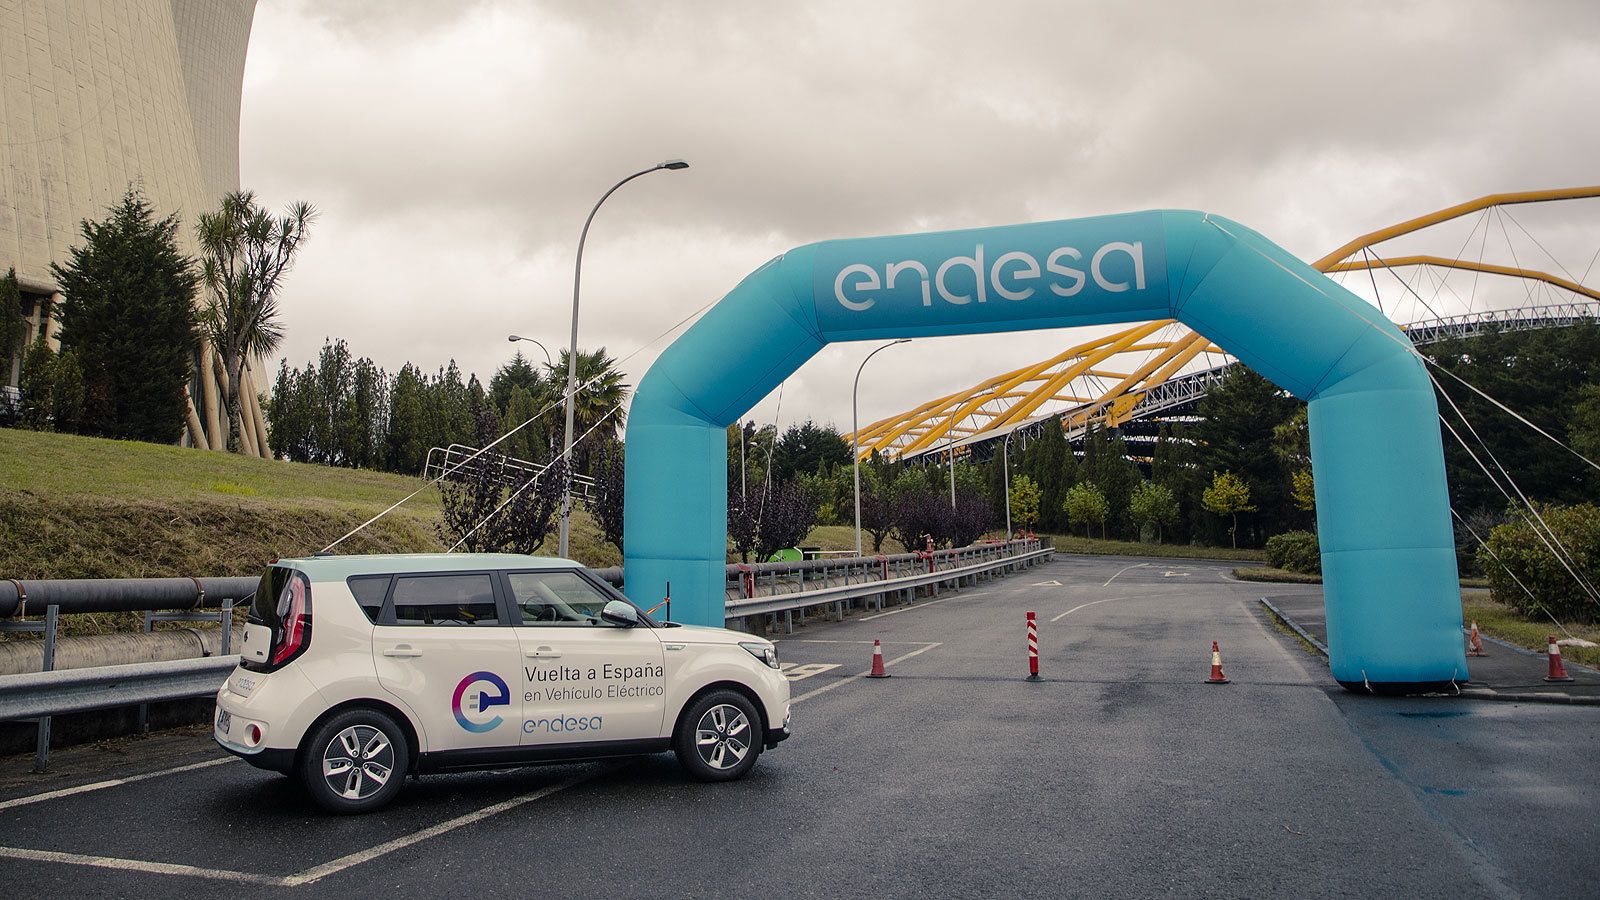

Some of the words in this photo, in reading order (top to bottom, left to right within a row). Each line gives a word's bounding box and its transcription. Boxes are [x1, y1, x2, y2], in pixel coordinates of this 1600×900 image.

[834, 241, 1146, 311] endesa
[525, 666, 580, 682] Vuelta
[587, 668, 597, 681] a
[603, 663, 663, 681] España
[524, 690, 541, 702] en
[545, 686, 602, 701] Vehículo
[607, 684, 663, 698] Eléctrico
[523, 714, 602, 734] endesa
